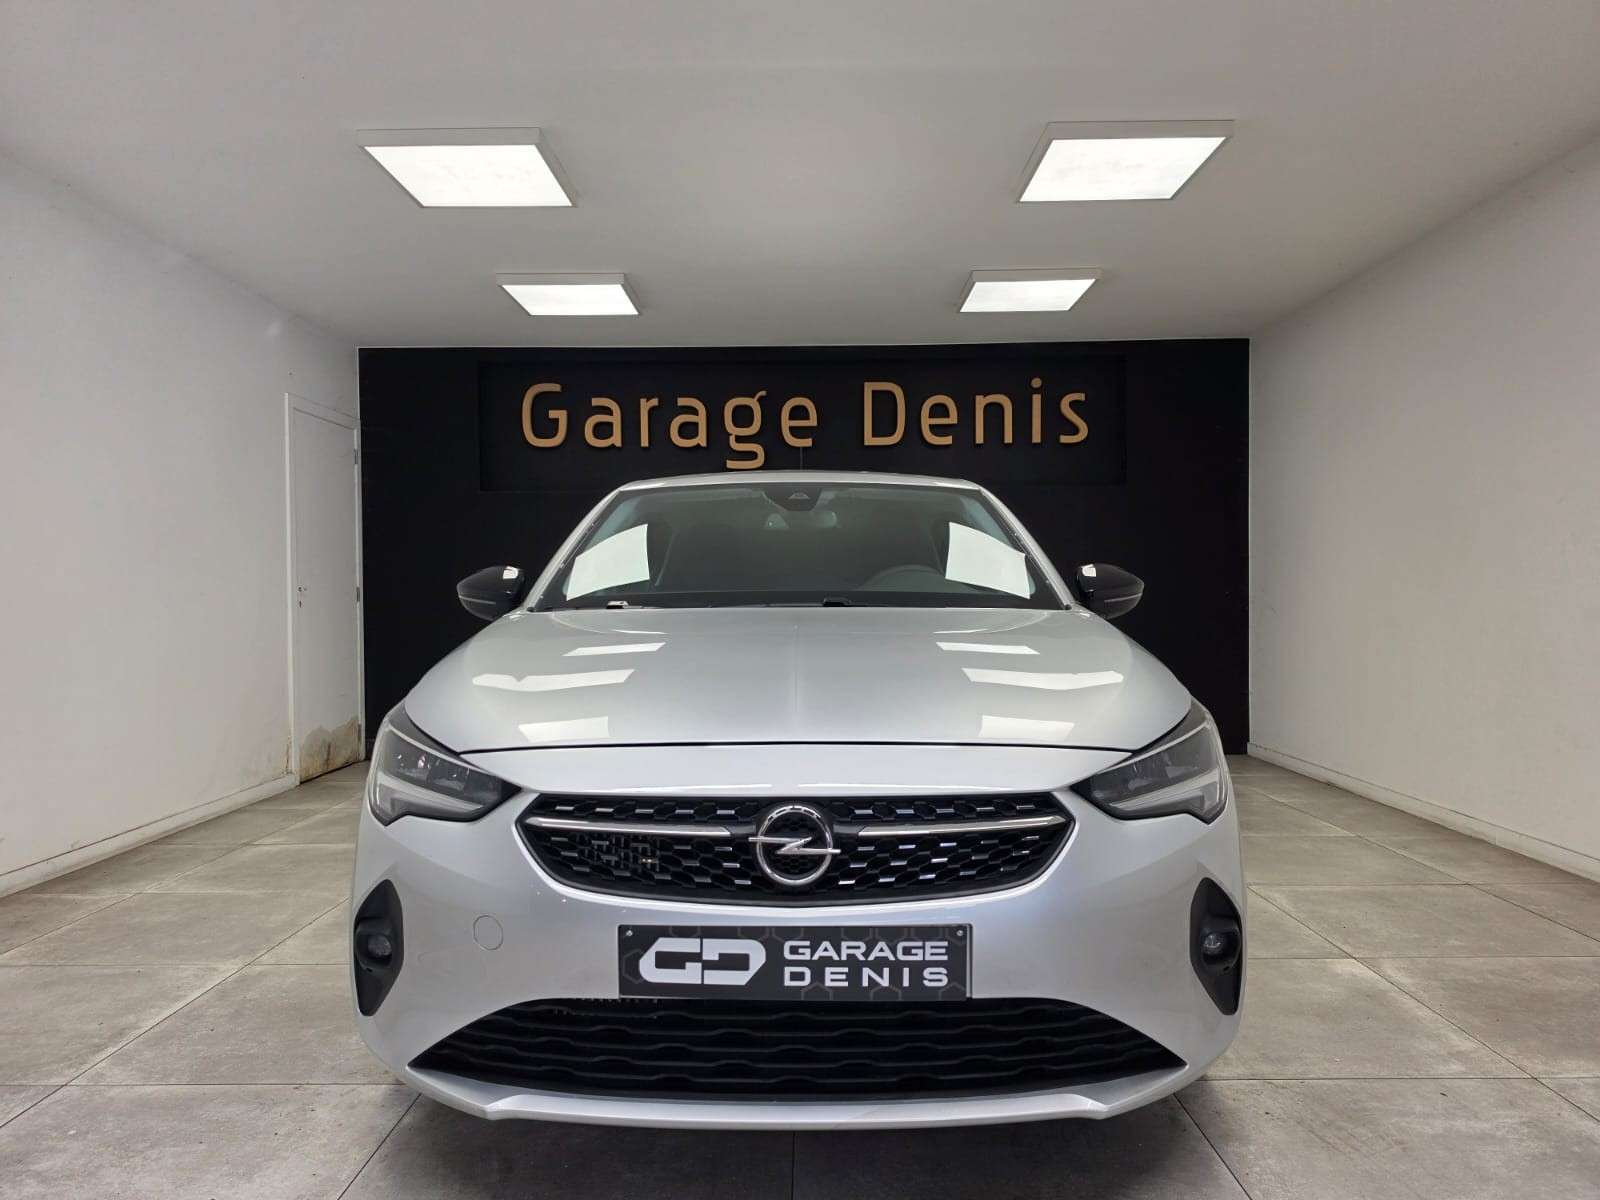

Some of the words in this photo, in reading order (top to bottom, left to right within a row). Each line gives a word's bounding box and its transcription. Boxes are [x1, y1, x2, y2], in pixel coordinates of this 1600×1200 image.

[521, 383, 819, 470] Garage
[863, 378, 1090, 447] Denis
[783, 940, 949, 961] GARAGE
[783, 966, 949, 987] DENIS
